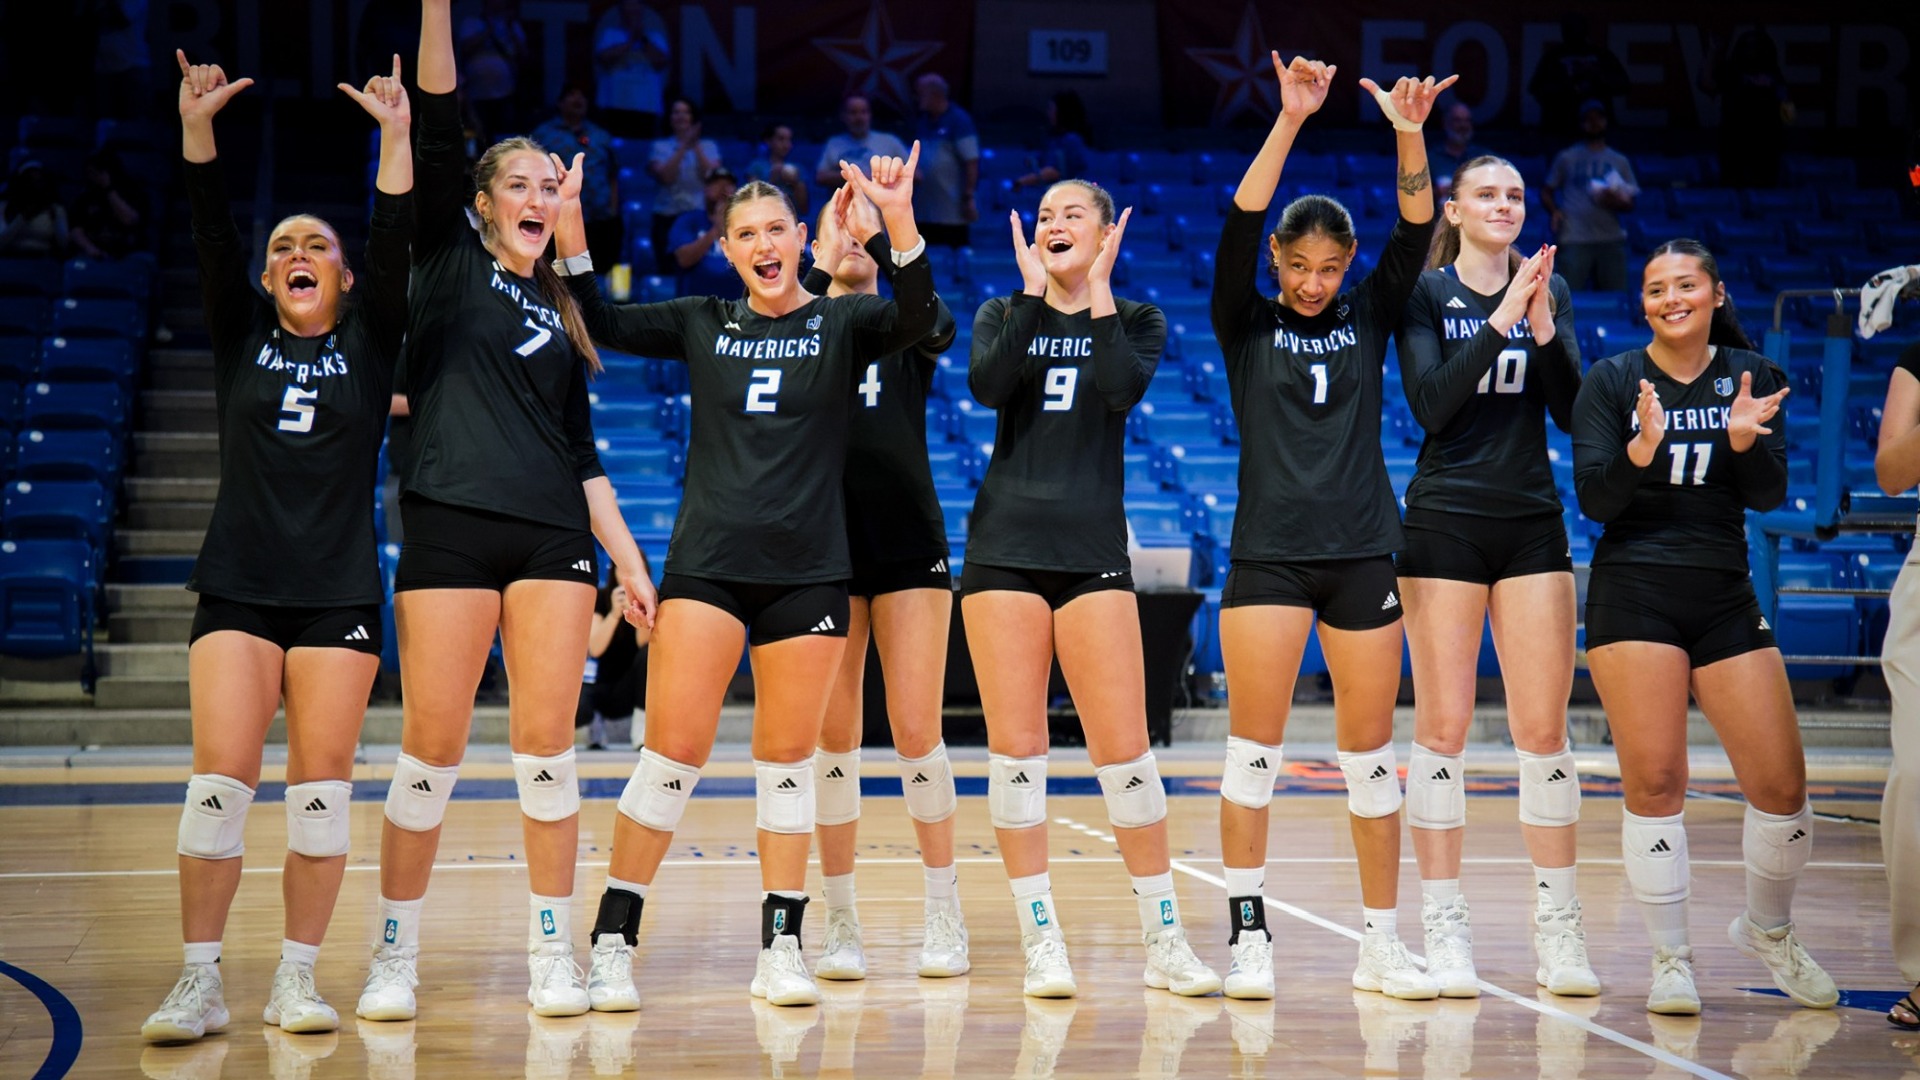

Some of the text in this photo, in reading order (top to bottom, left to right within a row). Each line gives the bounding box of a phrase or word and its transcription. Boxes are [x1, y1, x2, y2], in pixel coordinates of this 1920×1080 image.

[148, 0, 758, 112] RLITN
[1047, 38, 1091, 63] 109
[515, 317, 552, 357] 7
[715, 333, 820, 359] MAVERICKS
[1027, 337, 1092, 357] AVERIC
[745, 368, 782, 412] 2
[858, 364, 881, 407] 4
[1043, 367, 1078, 411] 9
[1311, 364, 1328, 403] 1
[278, 385, 318, 432] 5
[1631, 407, 1731, 430] MVERICK
[1669, 443, 1712, 486] 11
